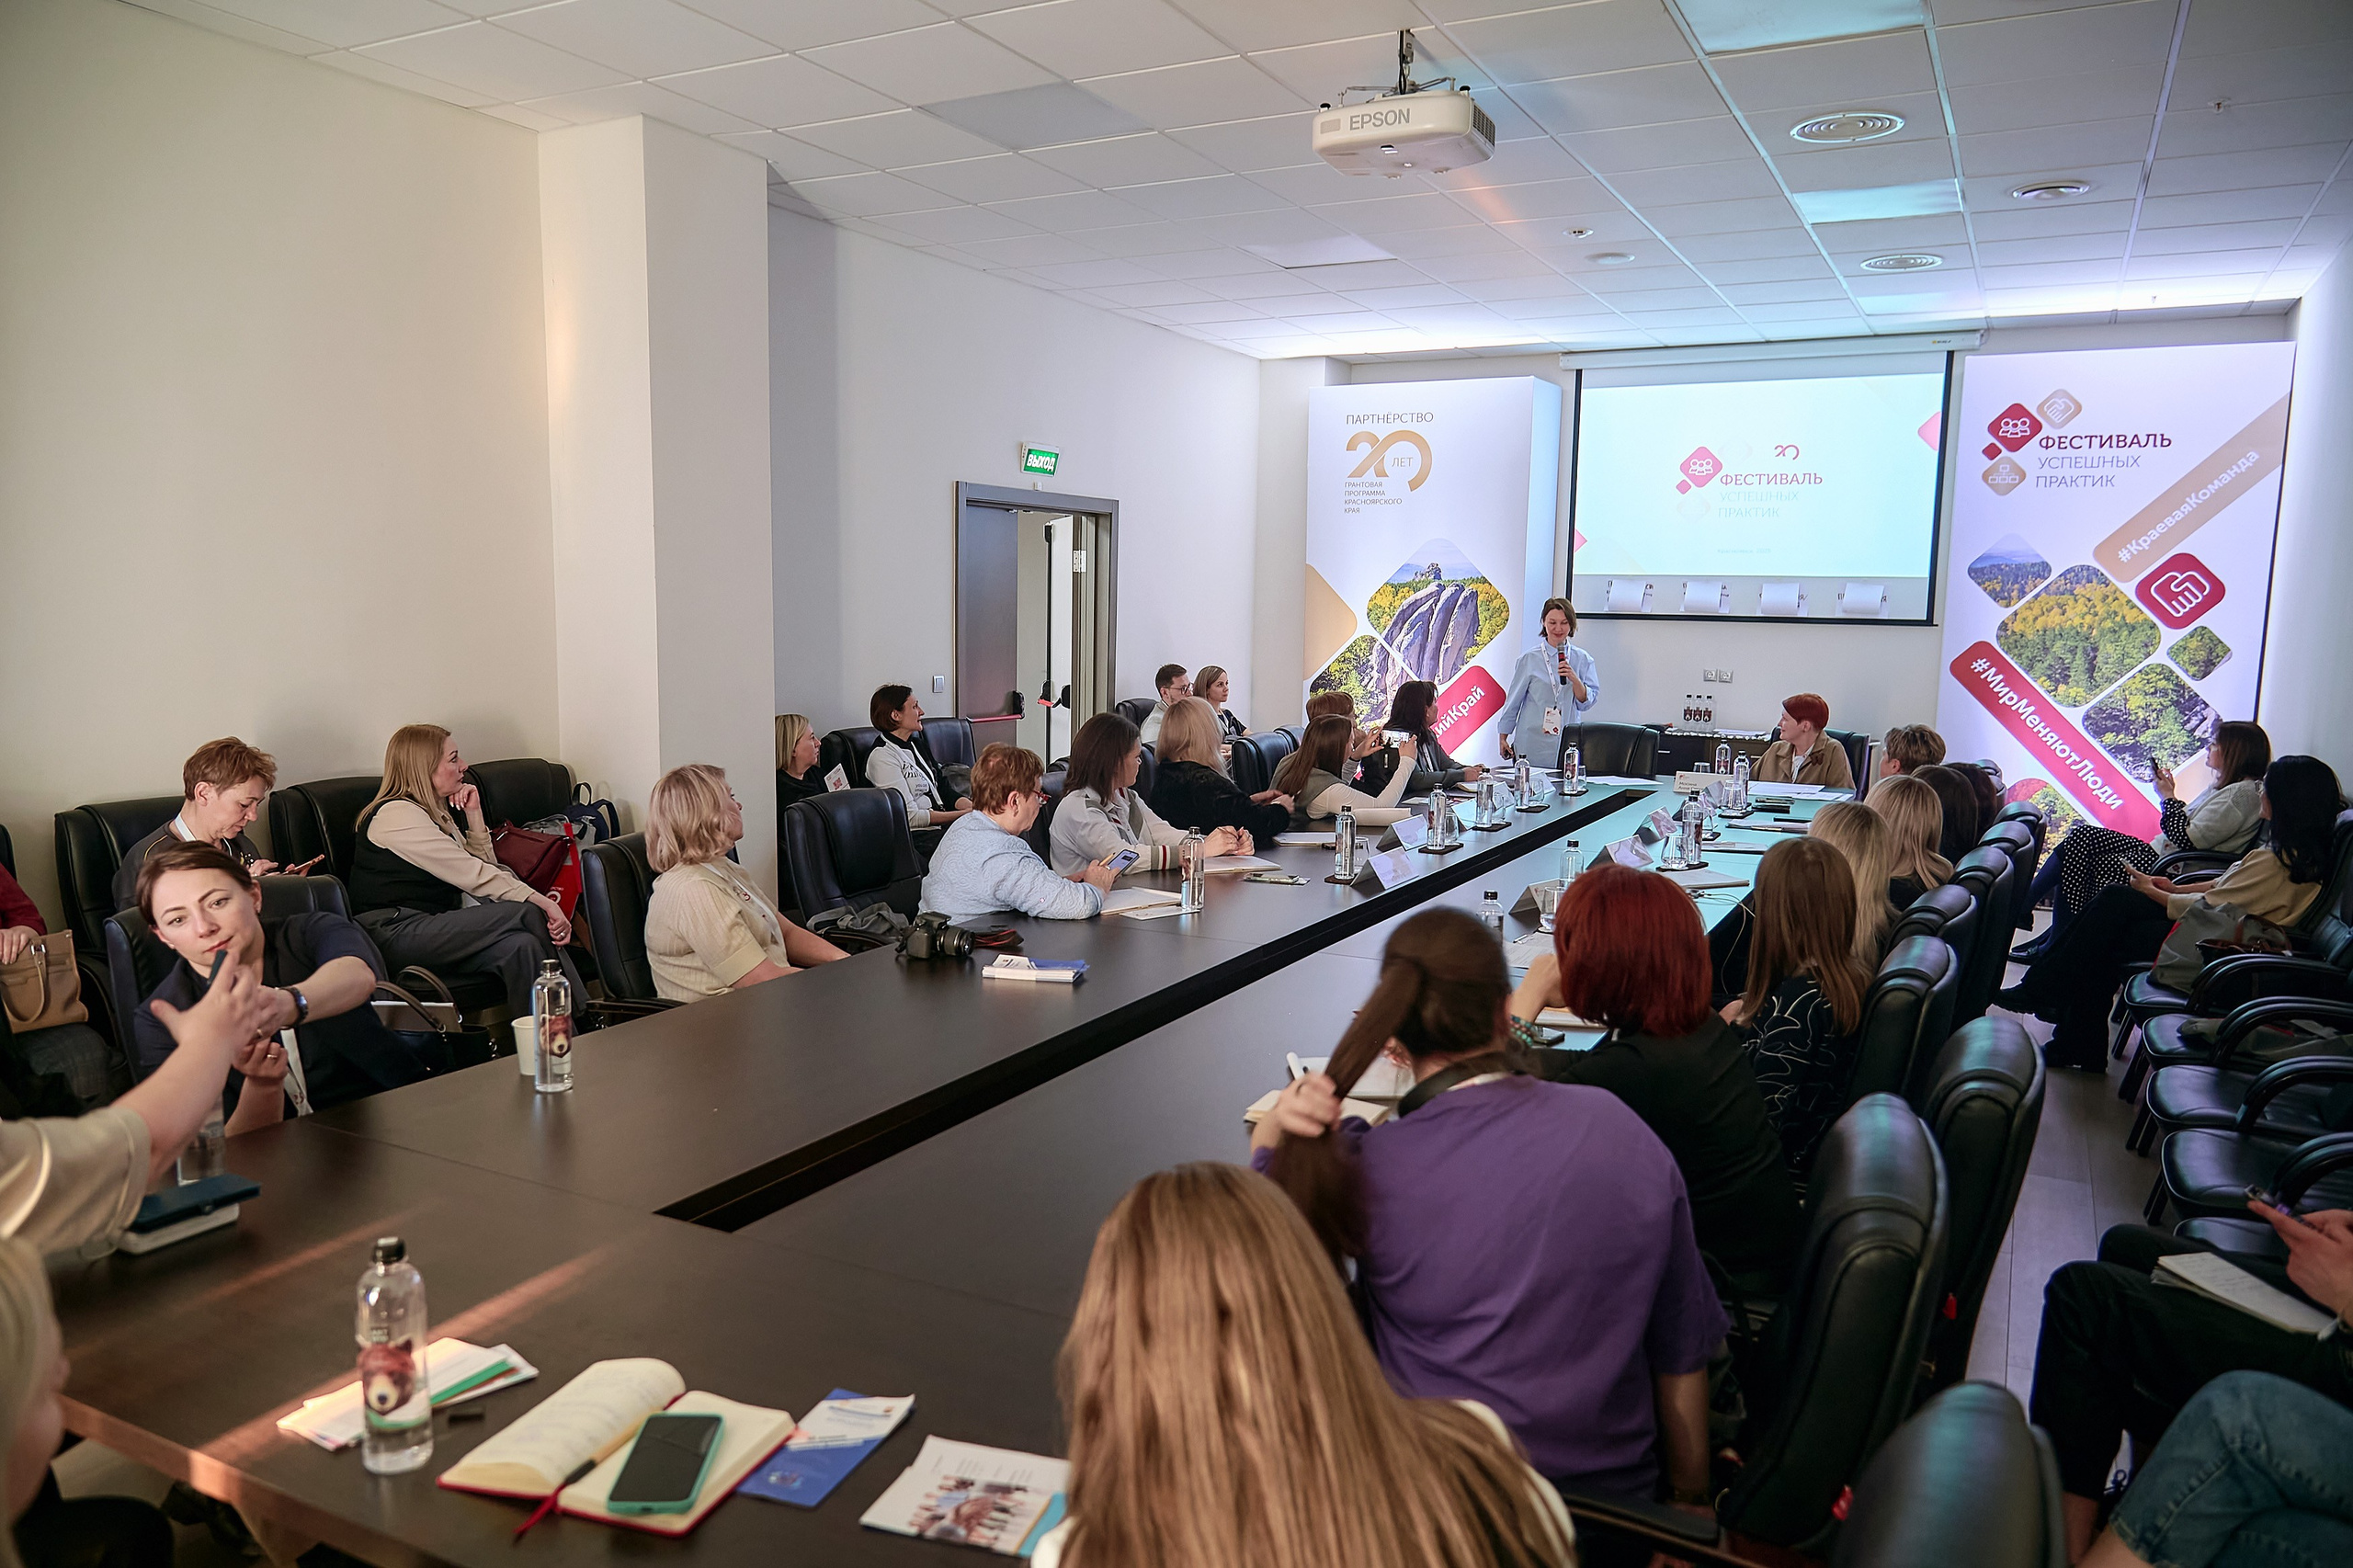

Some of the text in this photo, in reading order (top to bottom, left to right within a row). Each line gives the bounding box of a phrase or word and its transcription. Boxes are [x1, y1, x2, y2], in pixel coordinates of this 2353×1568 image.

[1349, 108, 1411, 131] EPSON
[1346, 411, 1434, 426] ПАРТНЁРСТВО
[2039, 433, 2173, 450] ФЕСТИВАЛЬ
[1026, 453, 1056, 472] ВЫХОД
[1392, 457, 1414, 467] ЛЕТ
[2038, 455, 2142, 470] УСПЕШНЫХ
[1720, 472, 1823, 486] ФЕСТИВАЛЬ
[2035, 474, 2115, 488] ПРАКТИК
[1720, 491, 1800, 502] УСПЕШНЫХ
[1718, 507, 1779, 518] ПРАКТИК
[2117, 449, 2260, 563] #КраеваяКоманда
[1434, 685, 1485, 738] ийКрай
[1970, 657, 2124, 811] #МирМеняютЛюди
